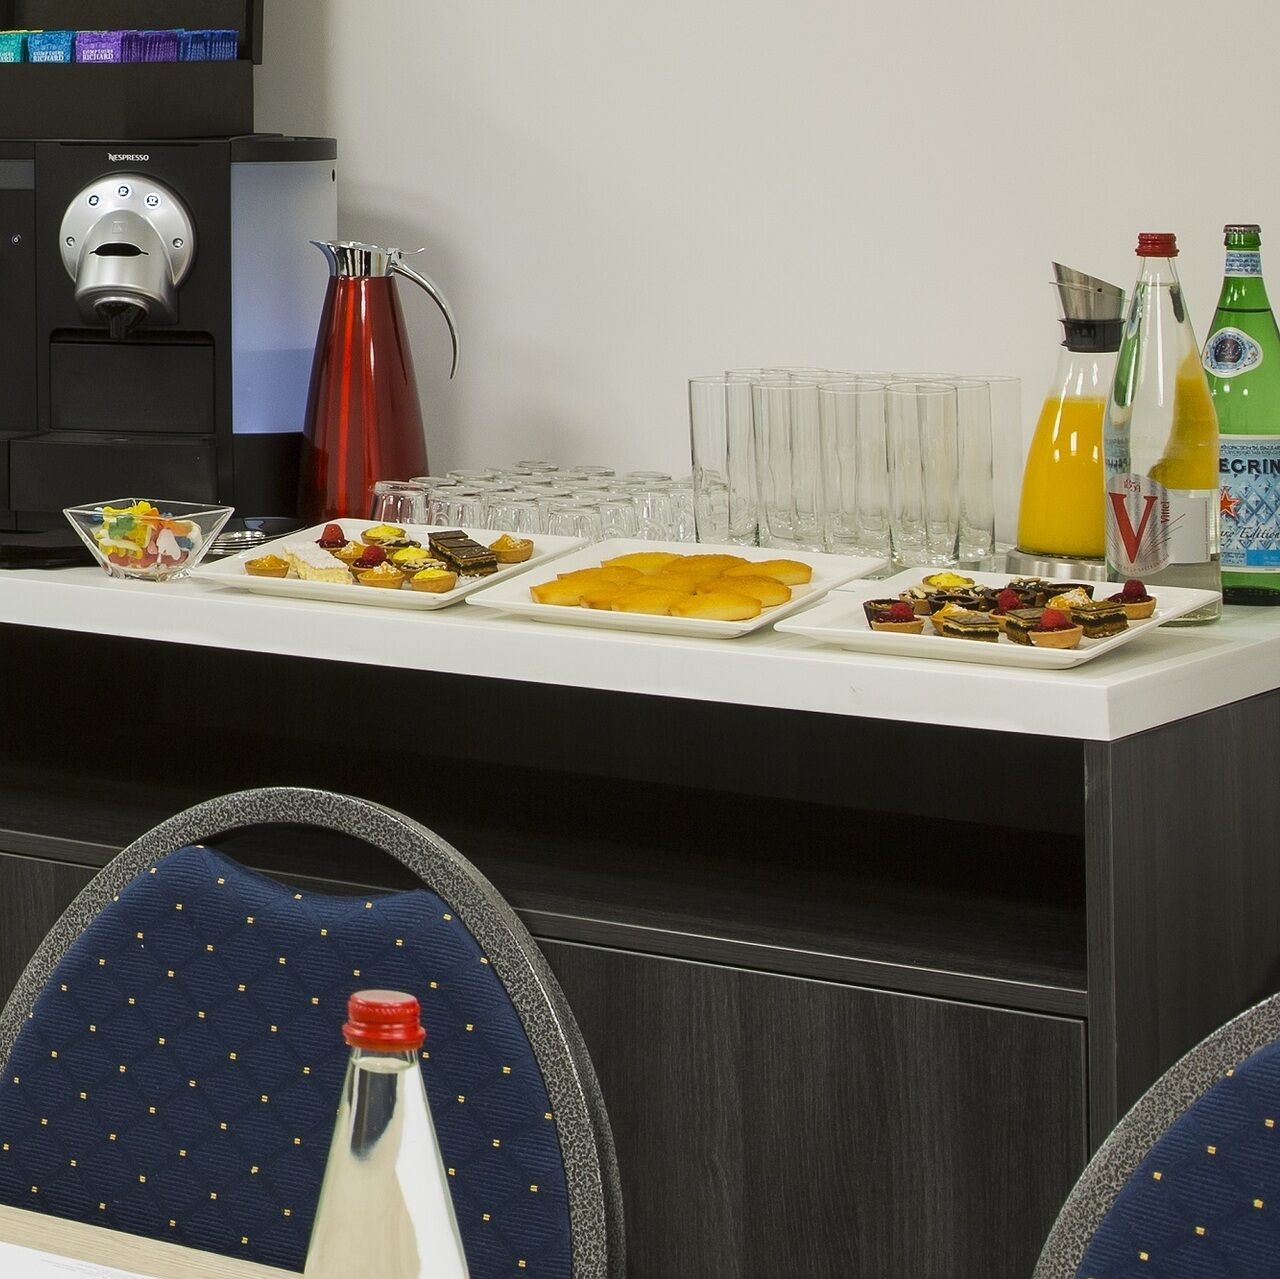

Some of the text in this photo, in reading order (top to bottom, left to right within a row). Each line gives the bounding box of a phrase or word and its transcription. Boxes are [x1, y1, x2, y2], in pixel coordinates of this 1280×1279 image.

[107, 152, 150, 162] NESPRESSO
[1160, 501, 1170, 524] Vittel
[1108, 492, 1158, 564] V
